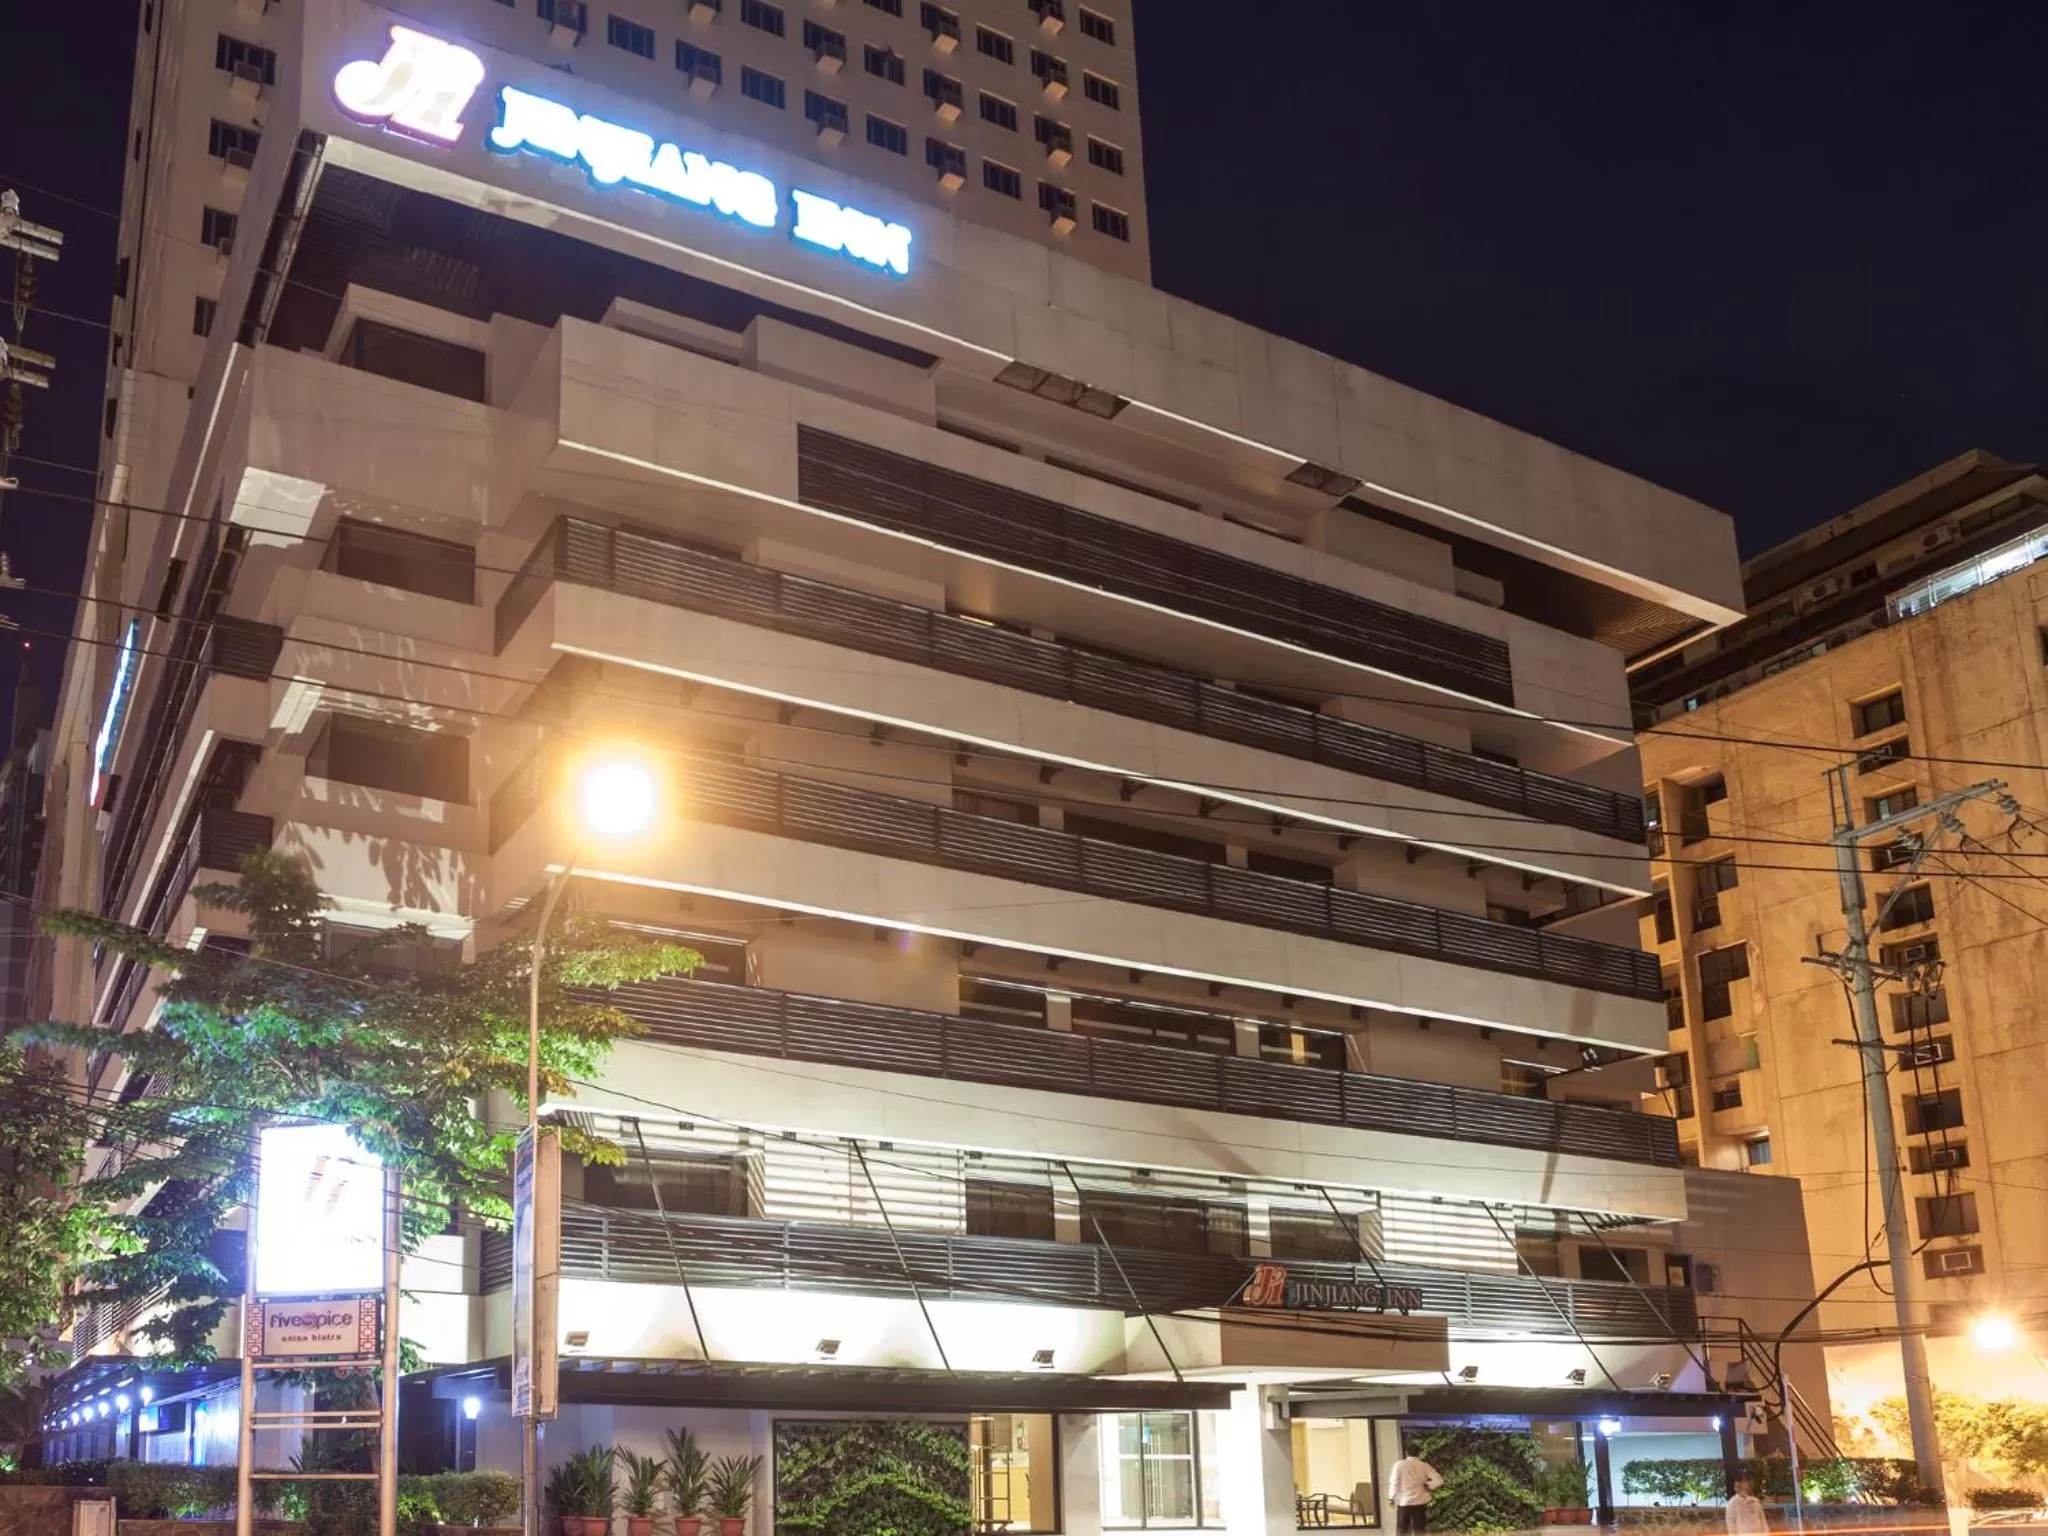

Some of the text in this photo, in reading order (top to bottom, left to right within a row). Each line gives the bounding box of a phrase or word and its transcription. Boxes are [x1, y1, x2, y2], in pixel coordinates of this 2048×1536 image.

[490, 86, 911, 275] JINJIANG INN
[1294, 1283, 1421, 1307] JINJIANG INN
